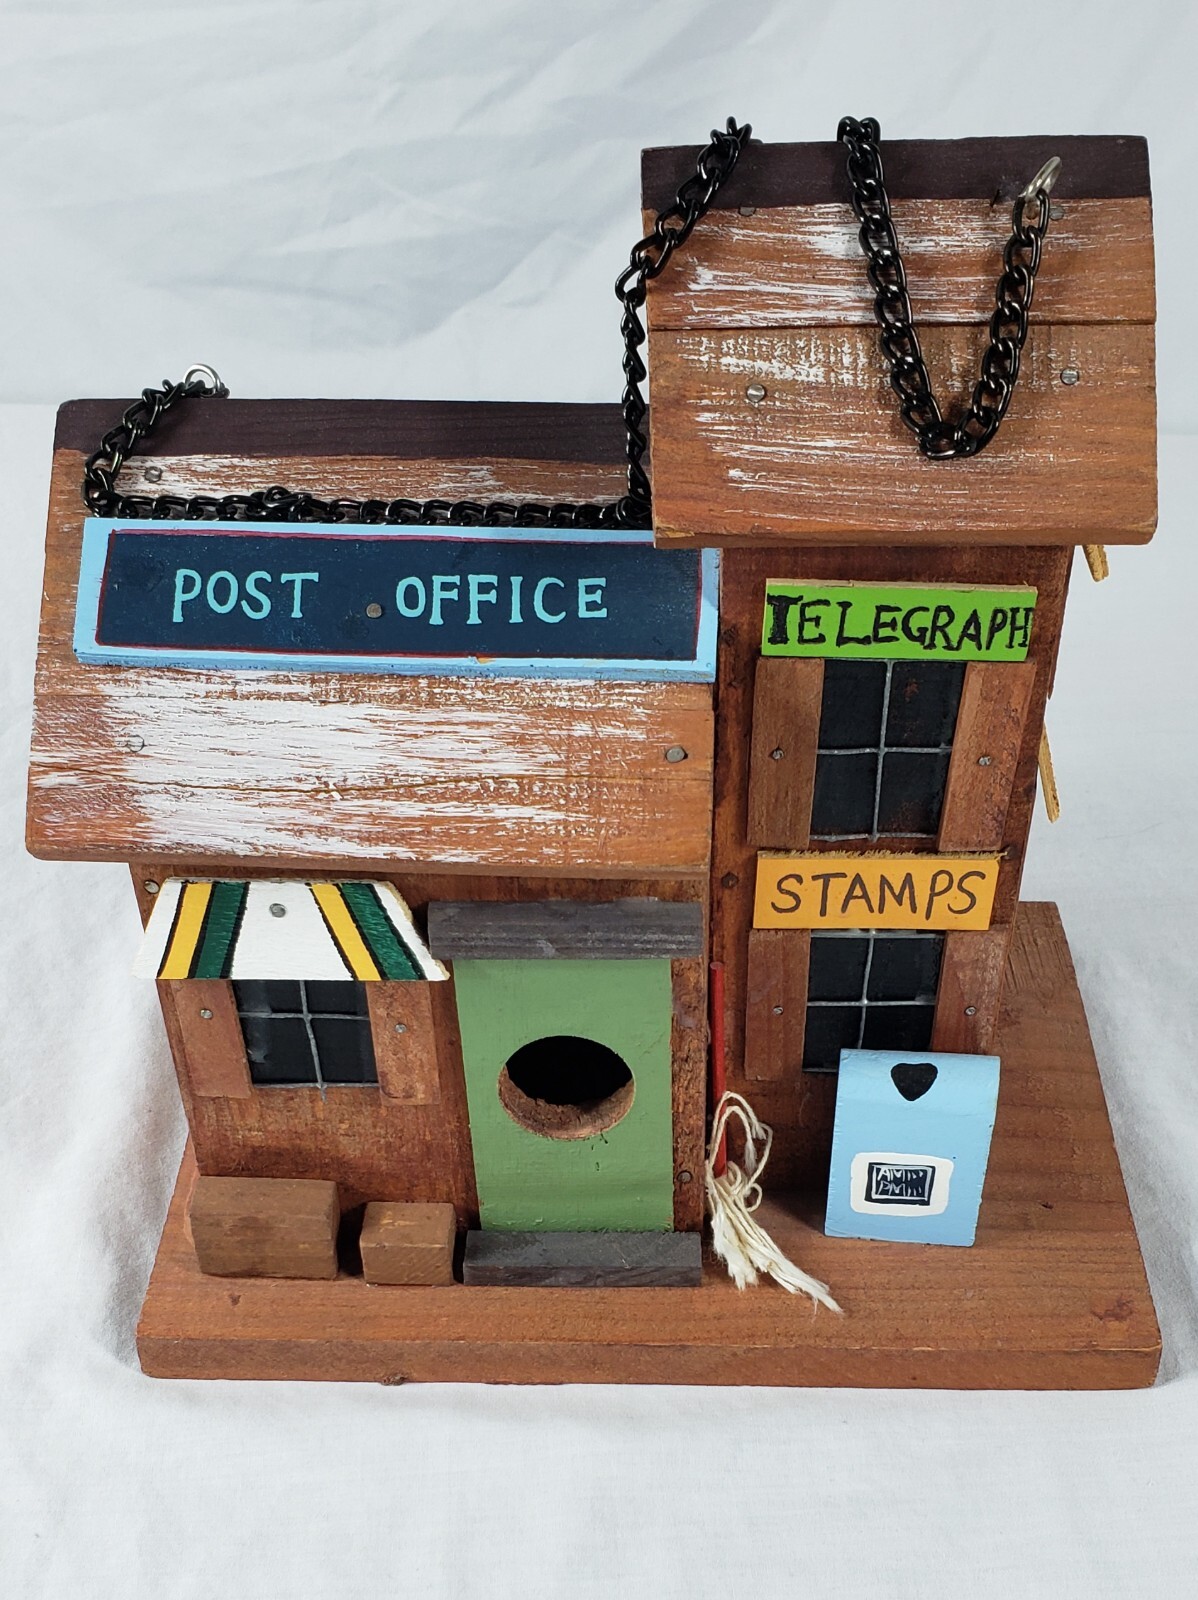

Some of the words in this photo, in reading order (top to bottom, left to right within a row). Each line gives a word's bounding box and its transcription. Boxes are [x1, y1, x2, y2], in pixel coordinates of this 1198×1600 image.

[172, 569, 319, 623] POST
[395, 574, 607, 625] OFFICE
[766, 593, 1033, 651] TELEGRAPH
[770, 870, 986, 920] STAMPS
